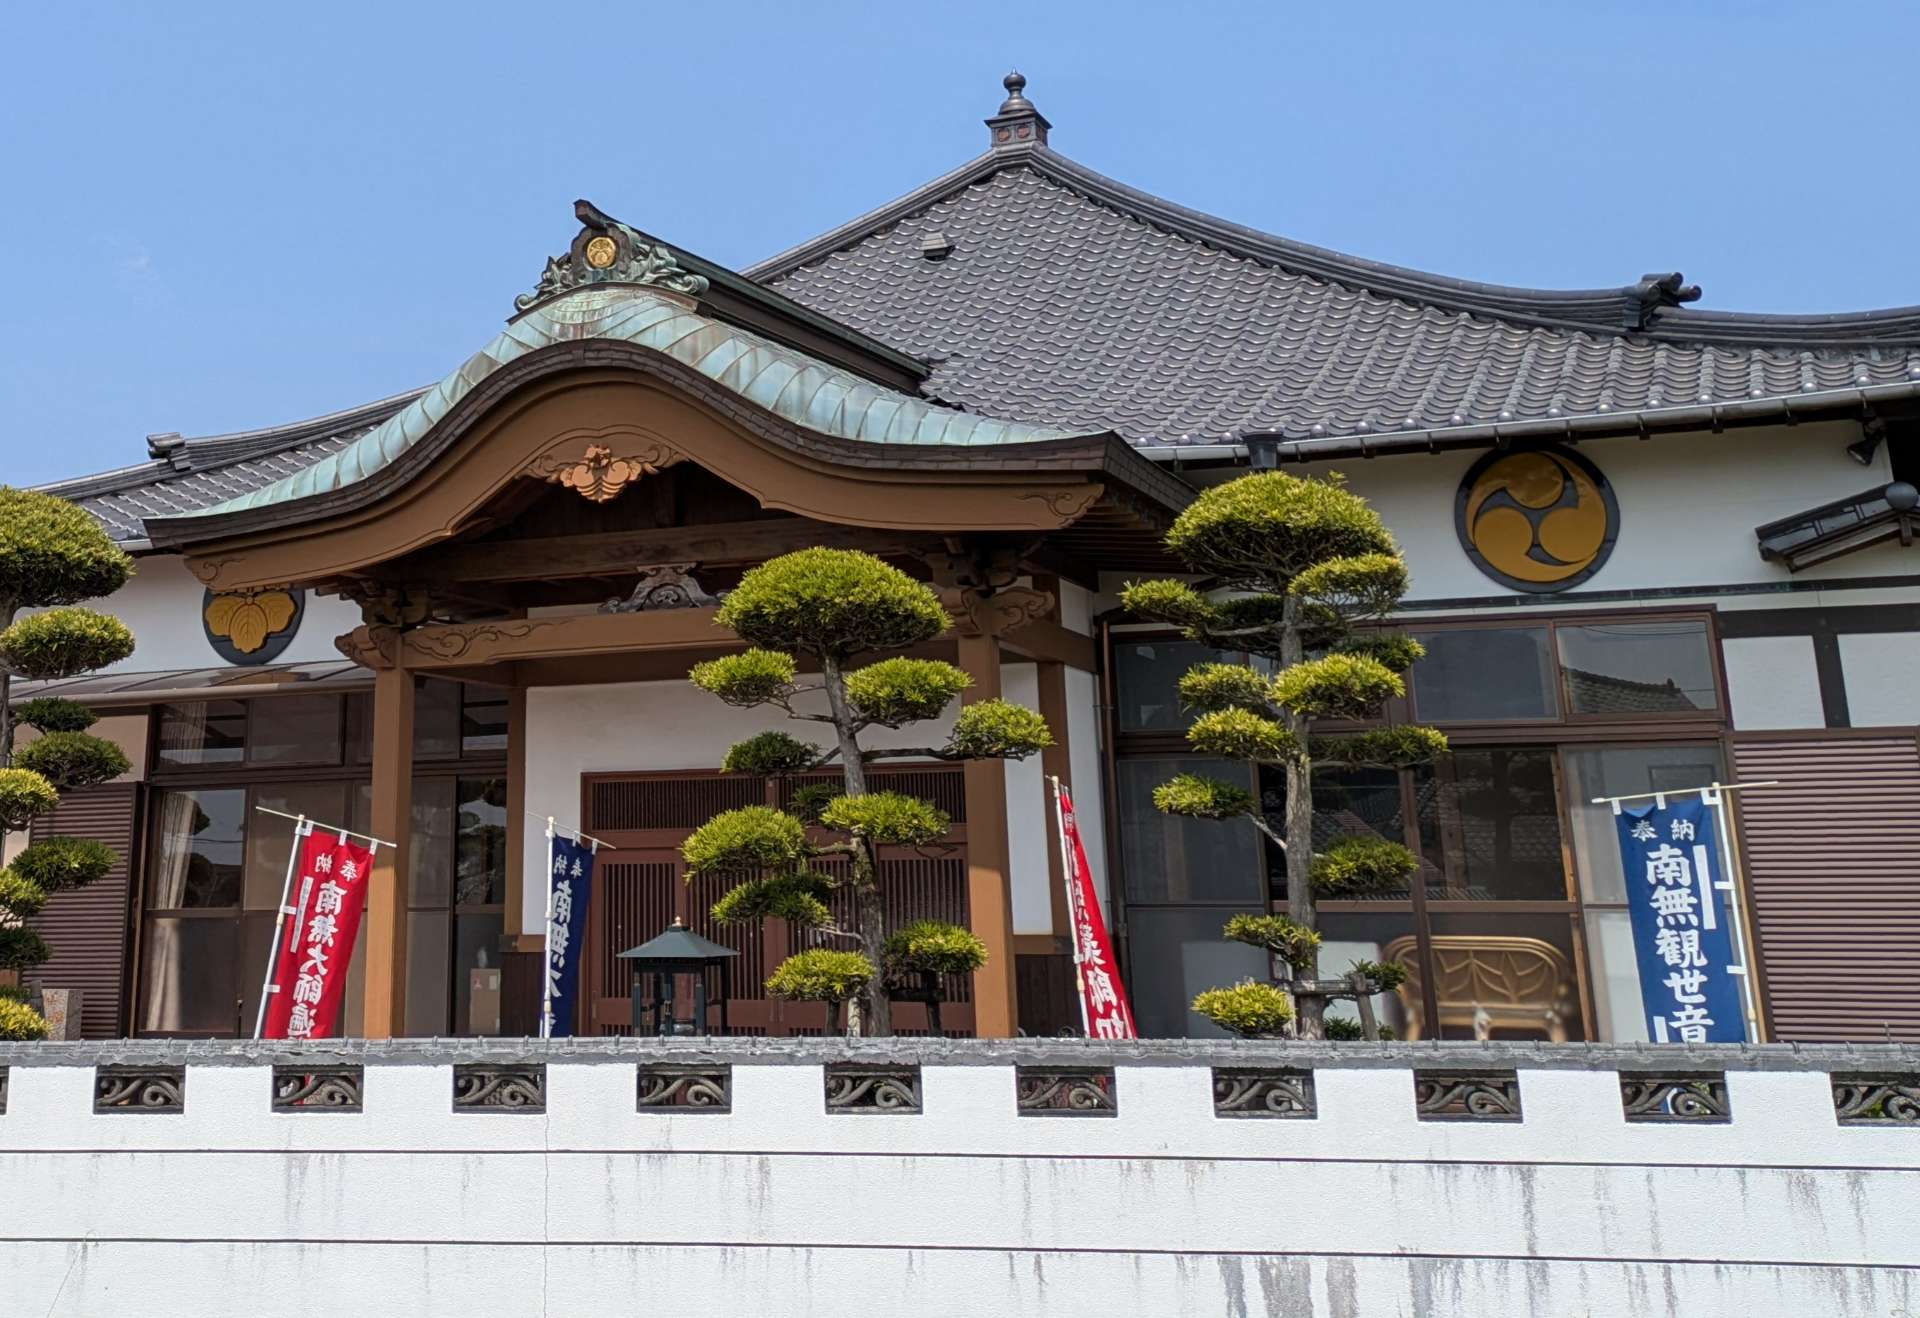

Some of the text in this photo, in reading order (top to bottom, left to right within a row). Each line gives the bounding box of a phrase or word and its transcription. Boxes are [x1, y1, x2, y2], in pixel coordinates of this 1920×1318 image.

[1631, 819, 1695, 841] 奉納
[1646, 843, 1714, 1043] 南無観世音
